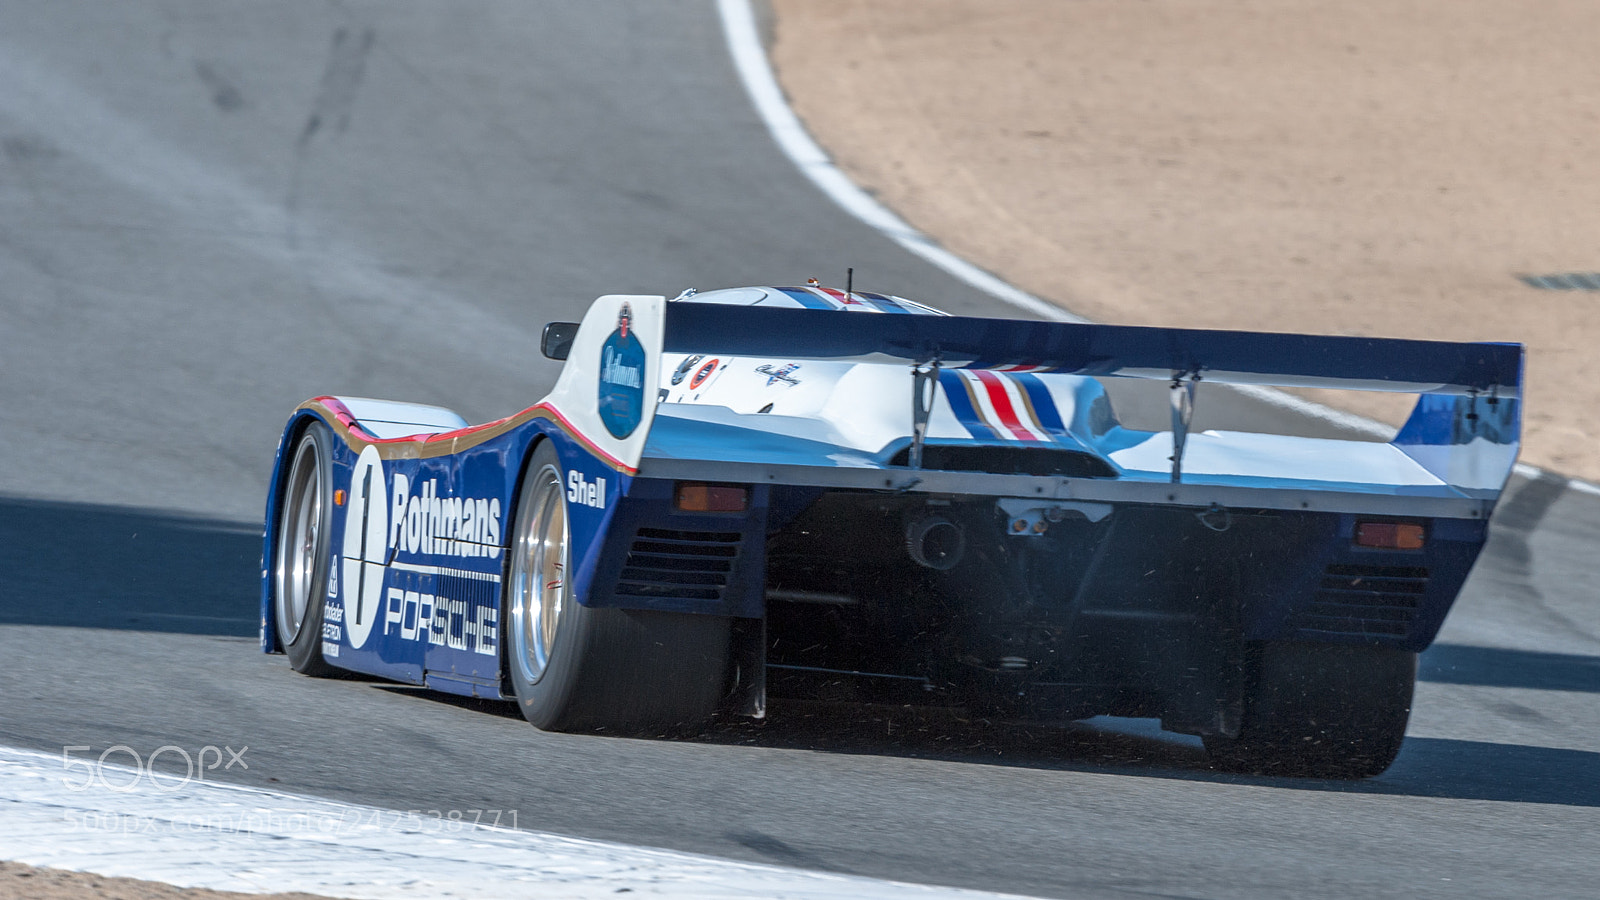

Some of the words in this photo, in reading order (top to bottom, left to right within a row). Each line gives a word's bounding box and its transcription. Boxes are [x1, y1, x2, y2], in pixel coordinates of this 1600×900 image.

[389, 473, 501, 559] Rothmans
[567, 469, 607, 509] Shell
[356, 464, 373, 626] 1
[384, 587, 498, 656] PORSCHE
